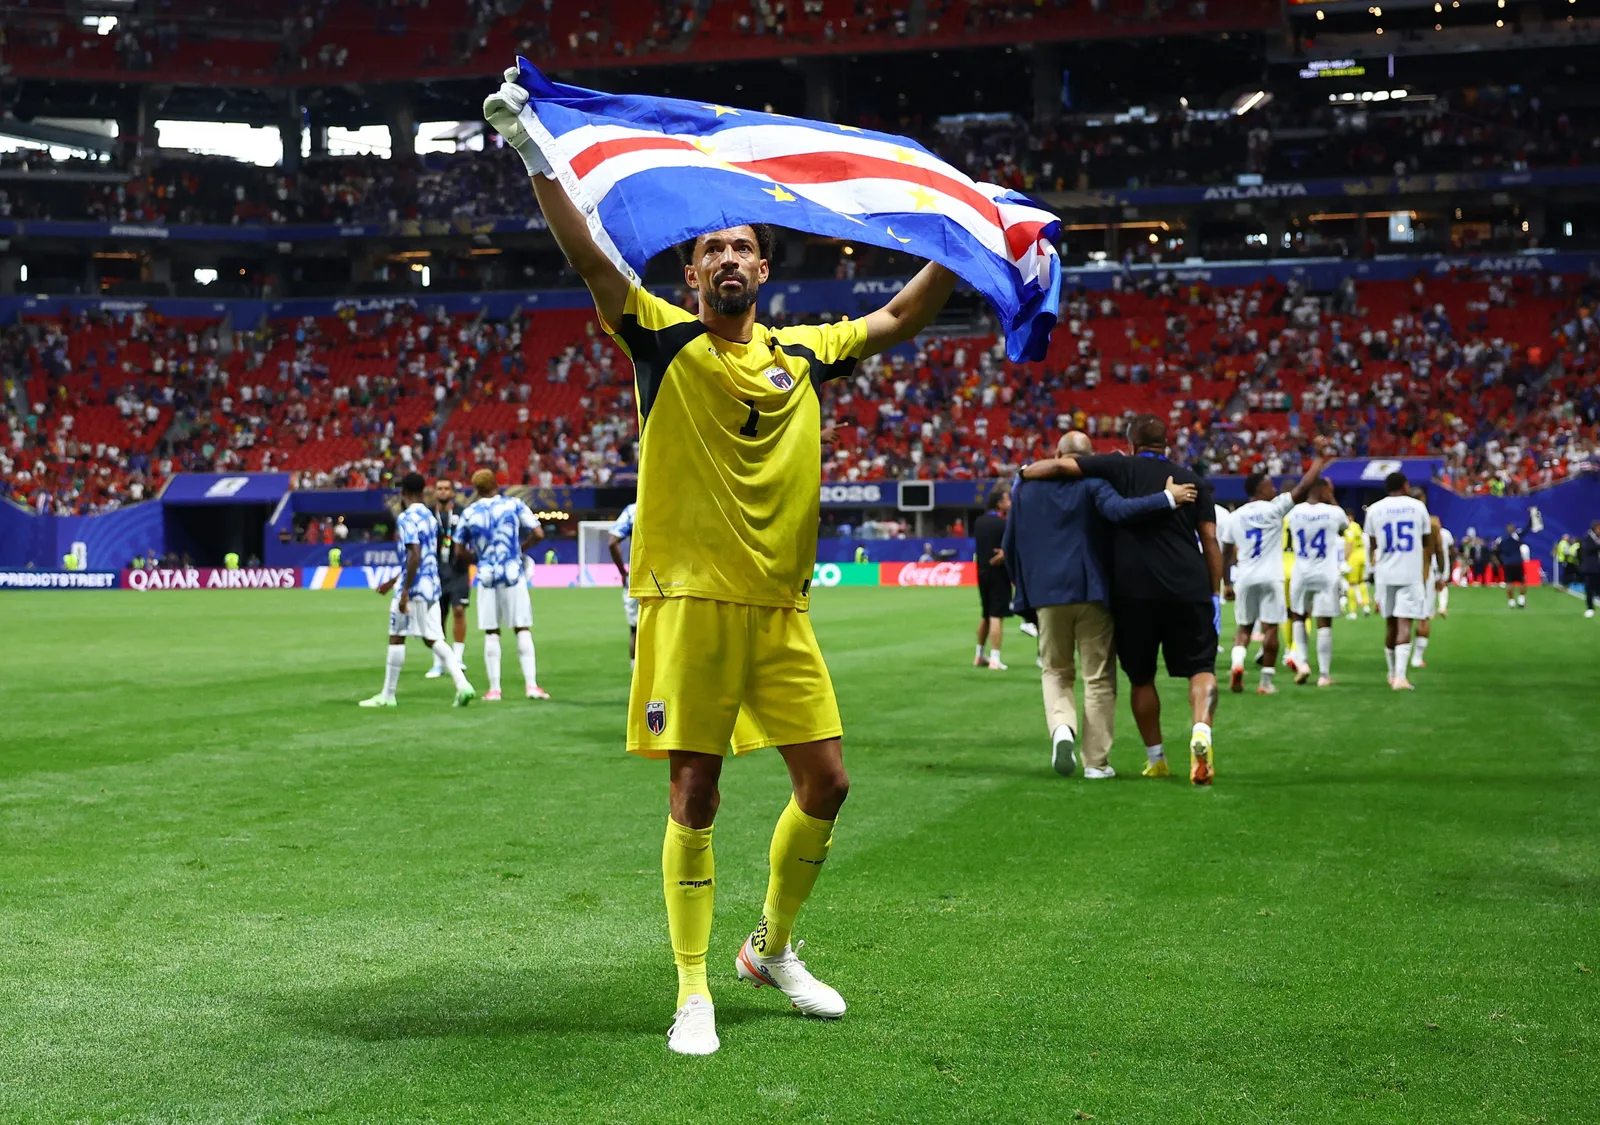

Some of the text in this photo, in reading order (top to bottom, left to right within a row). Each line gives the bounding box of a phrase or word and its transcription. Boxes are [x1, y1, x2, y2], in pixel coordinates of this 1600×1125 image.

[1203, 184, 1308, 200] ATLANTA
[1433, 258, 1543, 273] ATANTA
[740, 400, 760, 437] 1
[820, 485, 881, 502] 2026
[1245, 528, 1262, 559] 7
[1297, 528, 1326, 559] 14
[1383, 522, 1414, 552] 15
[364, 550, 399, 565] FIFA
[128, 568, 295, 592] QATAR AIRWAYS
